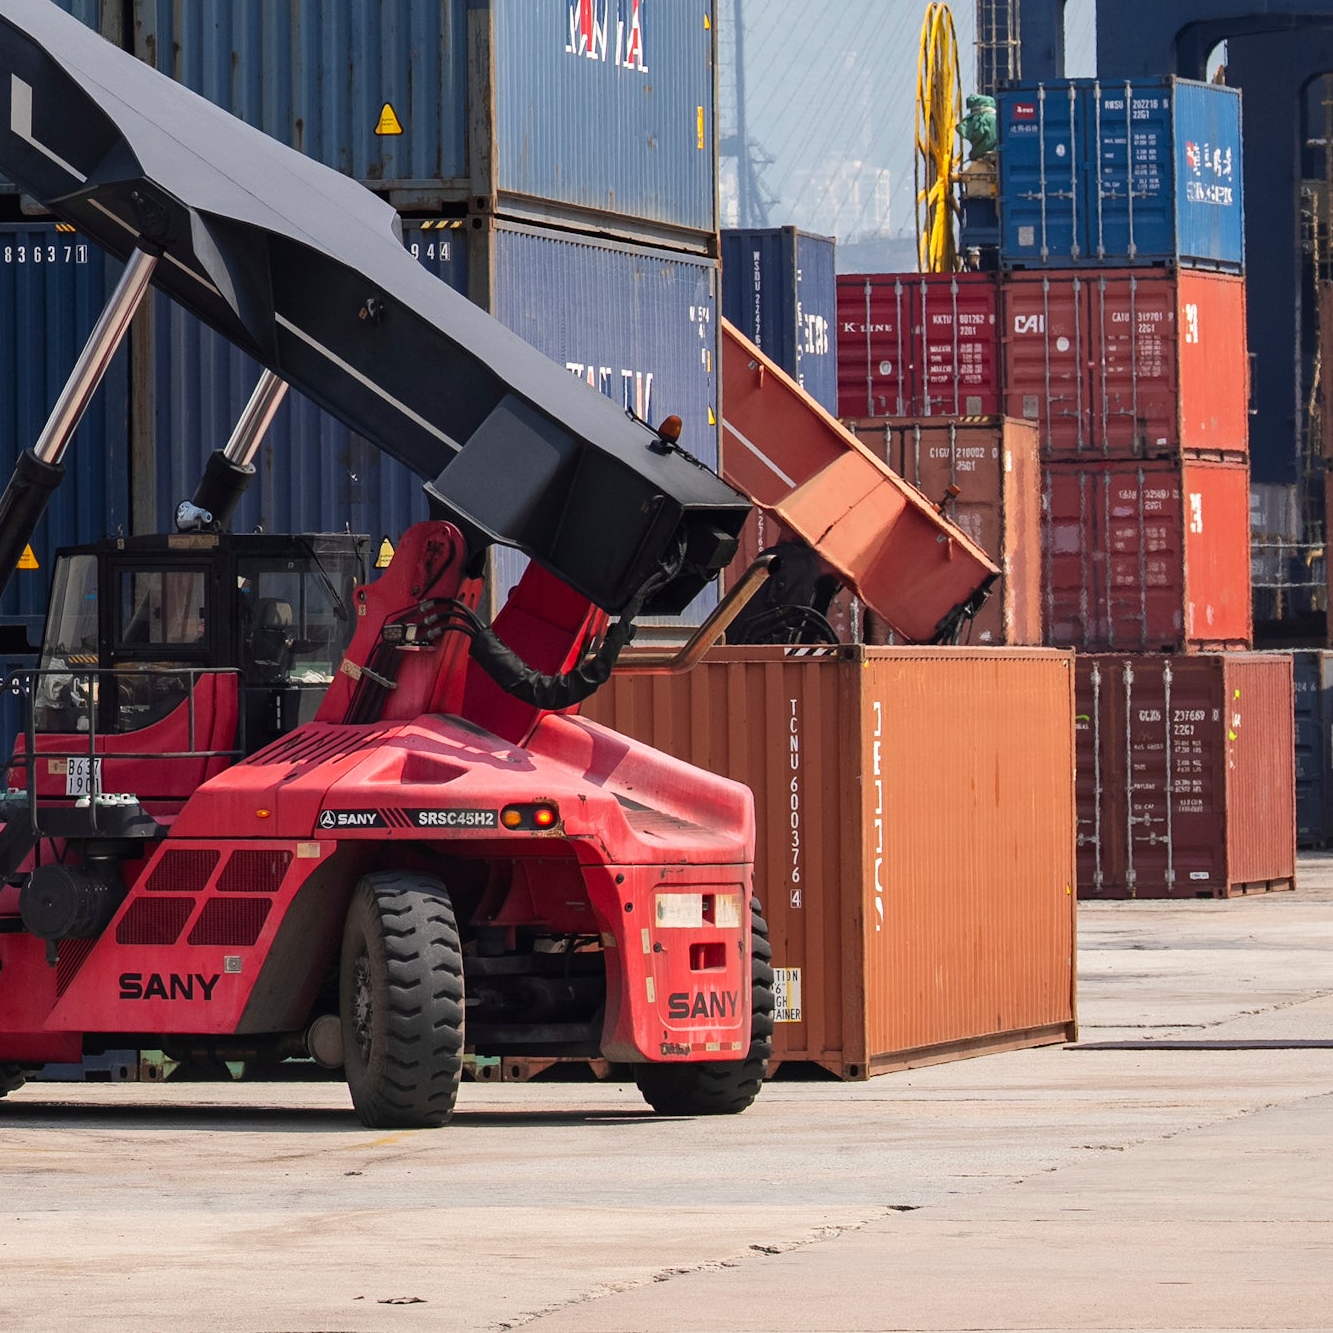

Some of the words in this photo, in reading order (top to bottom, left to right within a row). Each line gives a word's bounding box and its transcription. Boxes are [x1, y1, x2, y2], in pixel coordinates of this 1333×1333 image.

[1015, 315, 1045, 333] CAI
[790, 699, 798, 769] TCNU
[338, 814, 376, 824] SANY
[419, 812, 493, 825] SRSC45H2
[791, 777, 799, 882] 600376
[791, 890, 801, 908] 4
[119, 973, 220, 1000] SANY
[669, 991, 738, 1019] SANY
